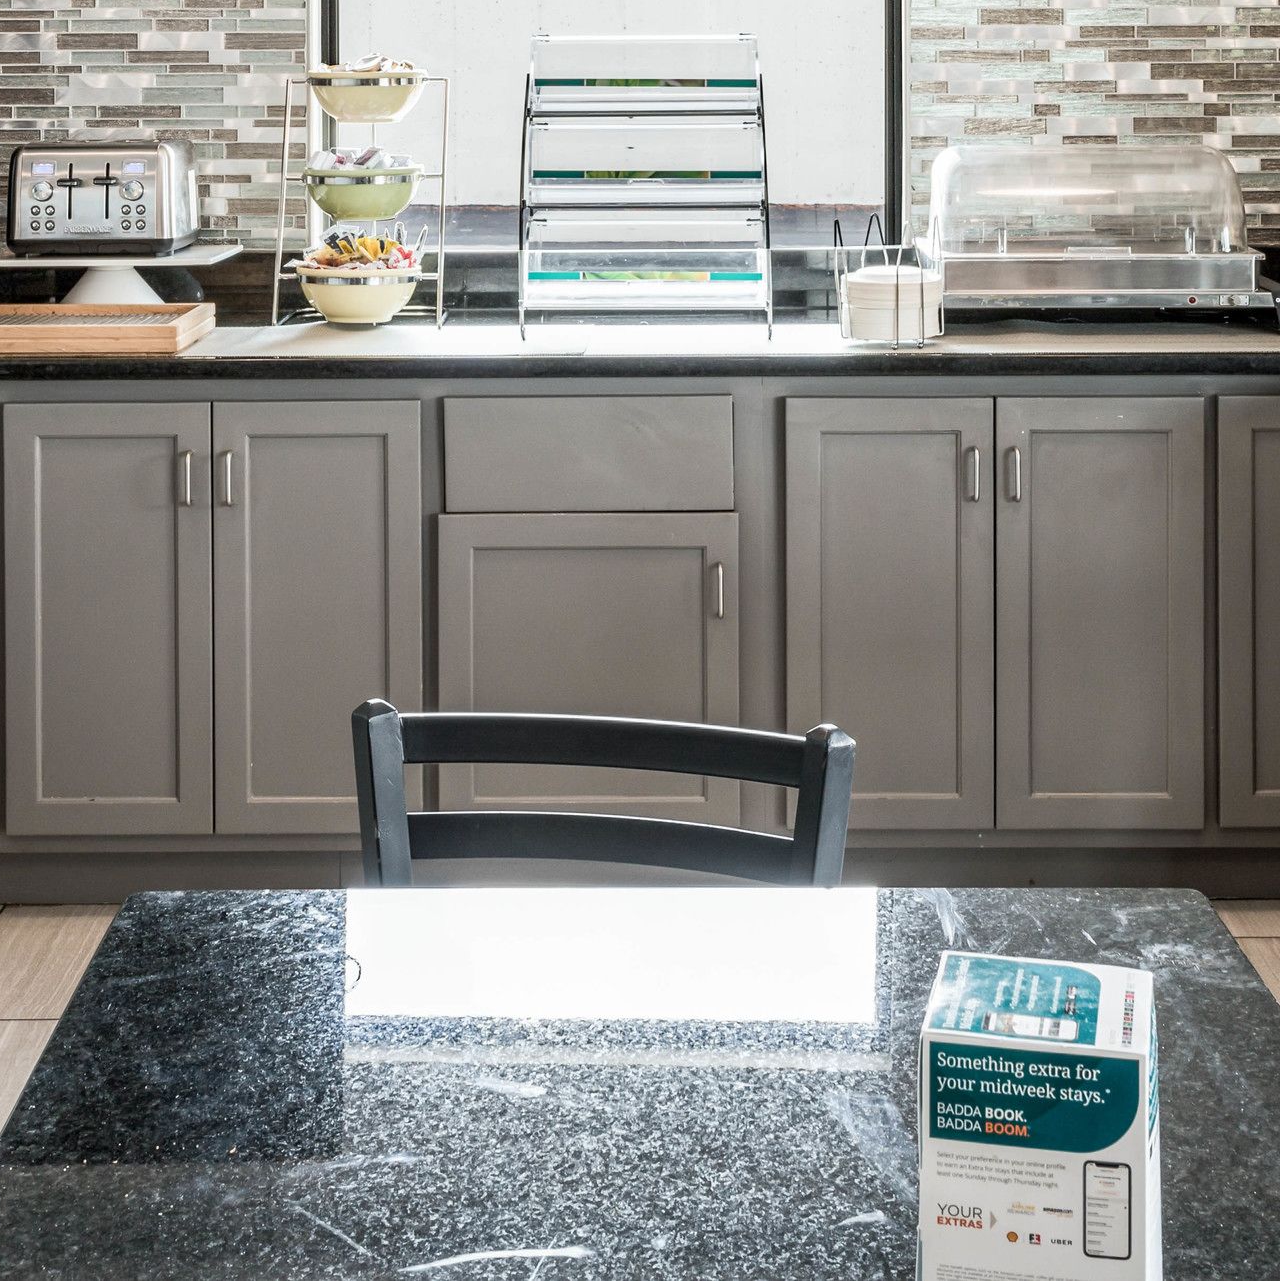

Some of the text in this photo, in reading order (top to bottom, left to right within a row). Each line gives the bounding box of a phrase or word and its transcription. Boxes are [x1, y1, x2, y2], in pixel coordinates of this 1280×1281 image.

[937, 1052, 1100, 1081] Something extra for
[937, 1076, 975, 1092] your
[980, 1079, 1056, 1099] midweek
[937, 1102, 1027, 1122] BADDA BOOK.
[937, 1117, 982, 1132] BADDA
[937, 1151, 954, 1159] Select
[970, 1155, 1002, 1163] preference
[1011, 1159, 1024, 1167] your
[965, 1173, 986, 1182] Sunday
[988, 1175, 1012, 1184] through
[1014, 1178, 1041, 1187] Thursday
[995, 1167, 1010, 1175] stays
[1025, 1170, 1046, 1178] include
[937, 1203, 982, 1219] YOUR
[937, 1216, 982, 1229] EXTRAS
[1050, 1238, 1072, 1246] UBER
